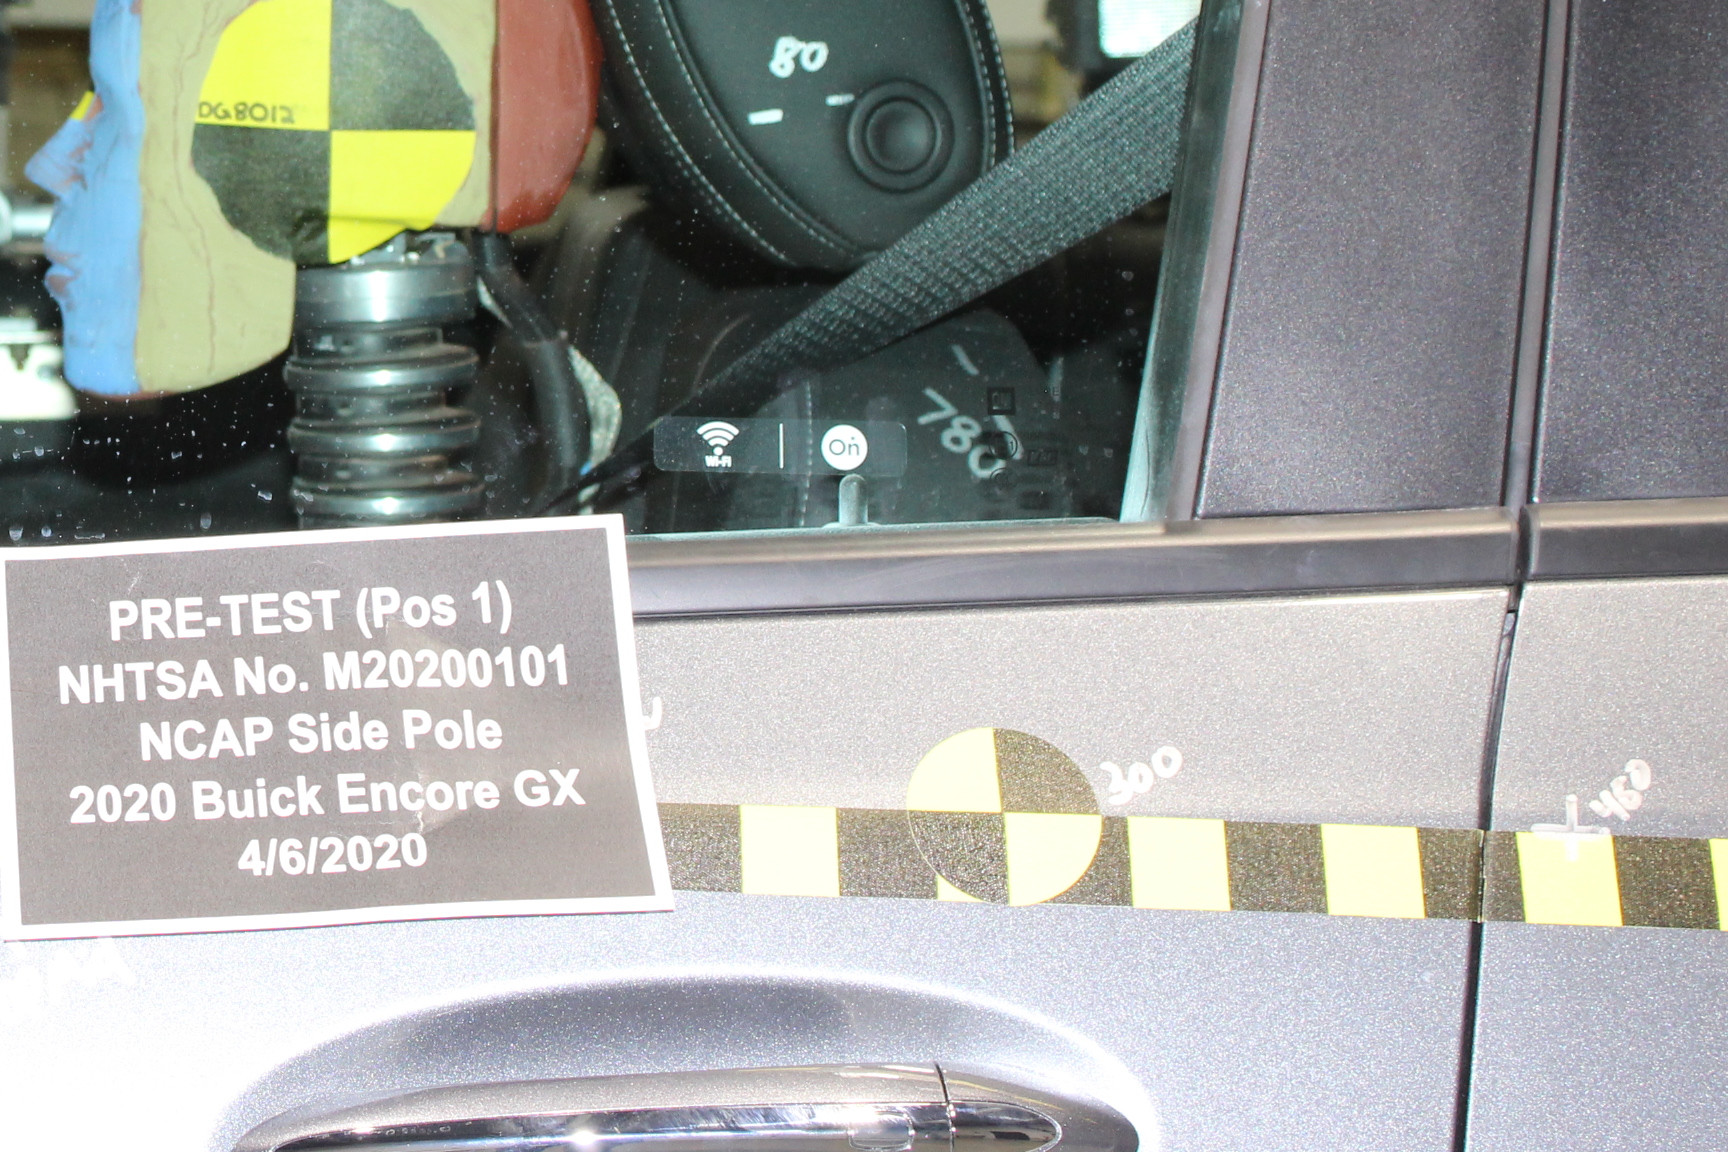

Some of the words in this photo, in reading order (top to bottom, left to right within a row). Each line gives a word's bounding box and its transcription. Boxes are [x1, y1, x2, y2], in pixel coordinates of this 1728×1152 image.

[768, 35, 830, 79] 80
[198, 100, 296, 125] DG8012
[109, 589, 341, 641] PRE-TEST
[356, 585, 457, 639] (Pos
[471, 579, 513, 634] 1)
[58, 659, 224, 705] NHTSA
[233, 656, 309, 696] No.
[322, 643, 568, 691] M20200101
[139, 716, 274, 761] NCAP
[288, 710, 389, 754] Side
[402, 708, 503, 750] Pole
[69, 782, 176, 824] 2020
[192, 775, 325, 820] Buick
[336, 772, 500, 814] Encore
[513, 768, 586, 807] GX
[1099, 745, 1183, 806] 300
[237, 832, 428, 876] 4/6/2020
